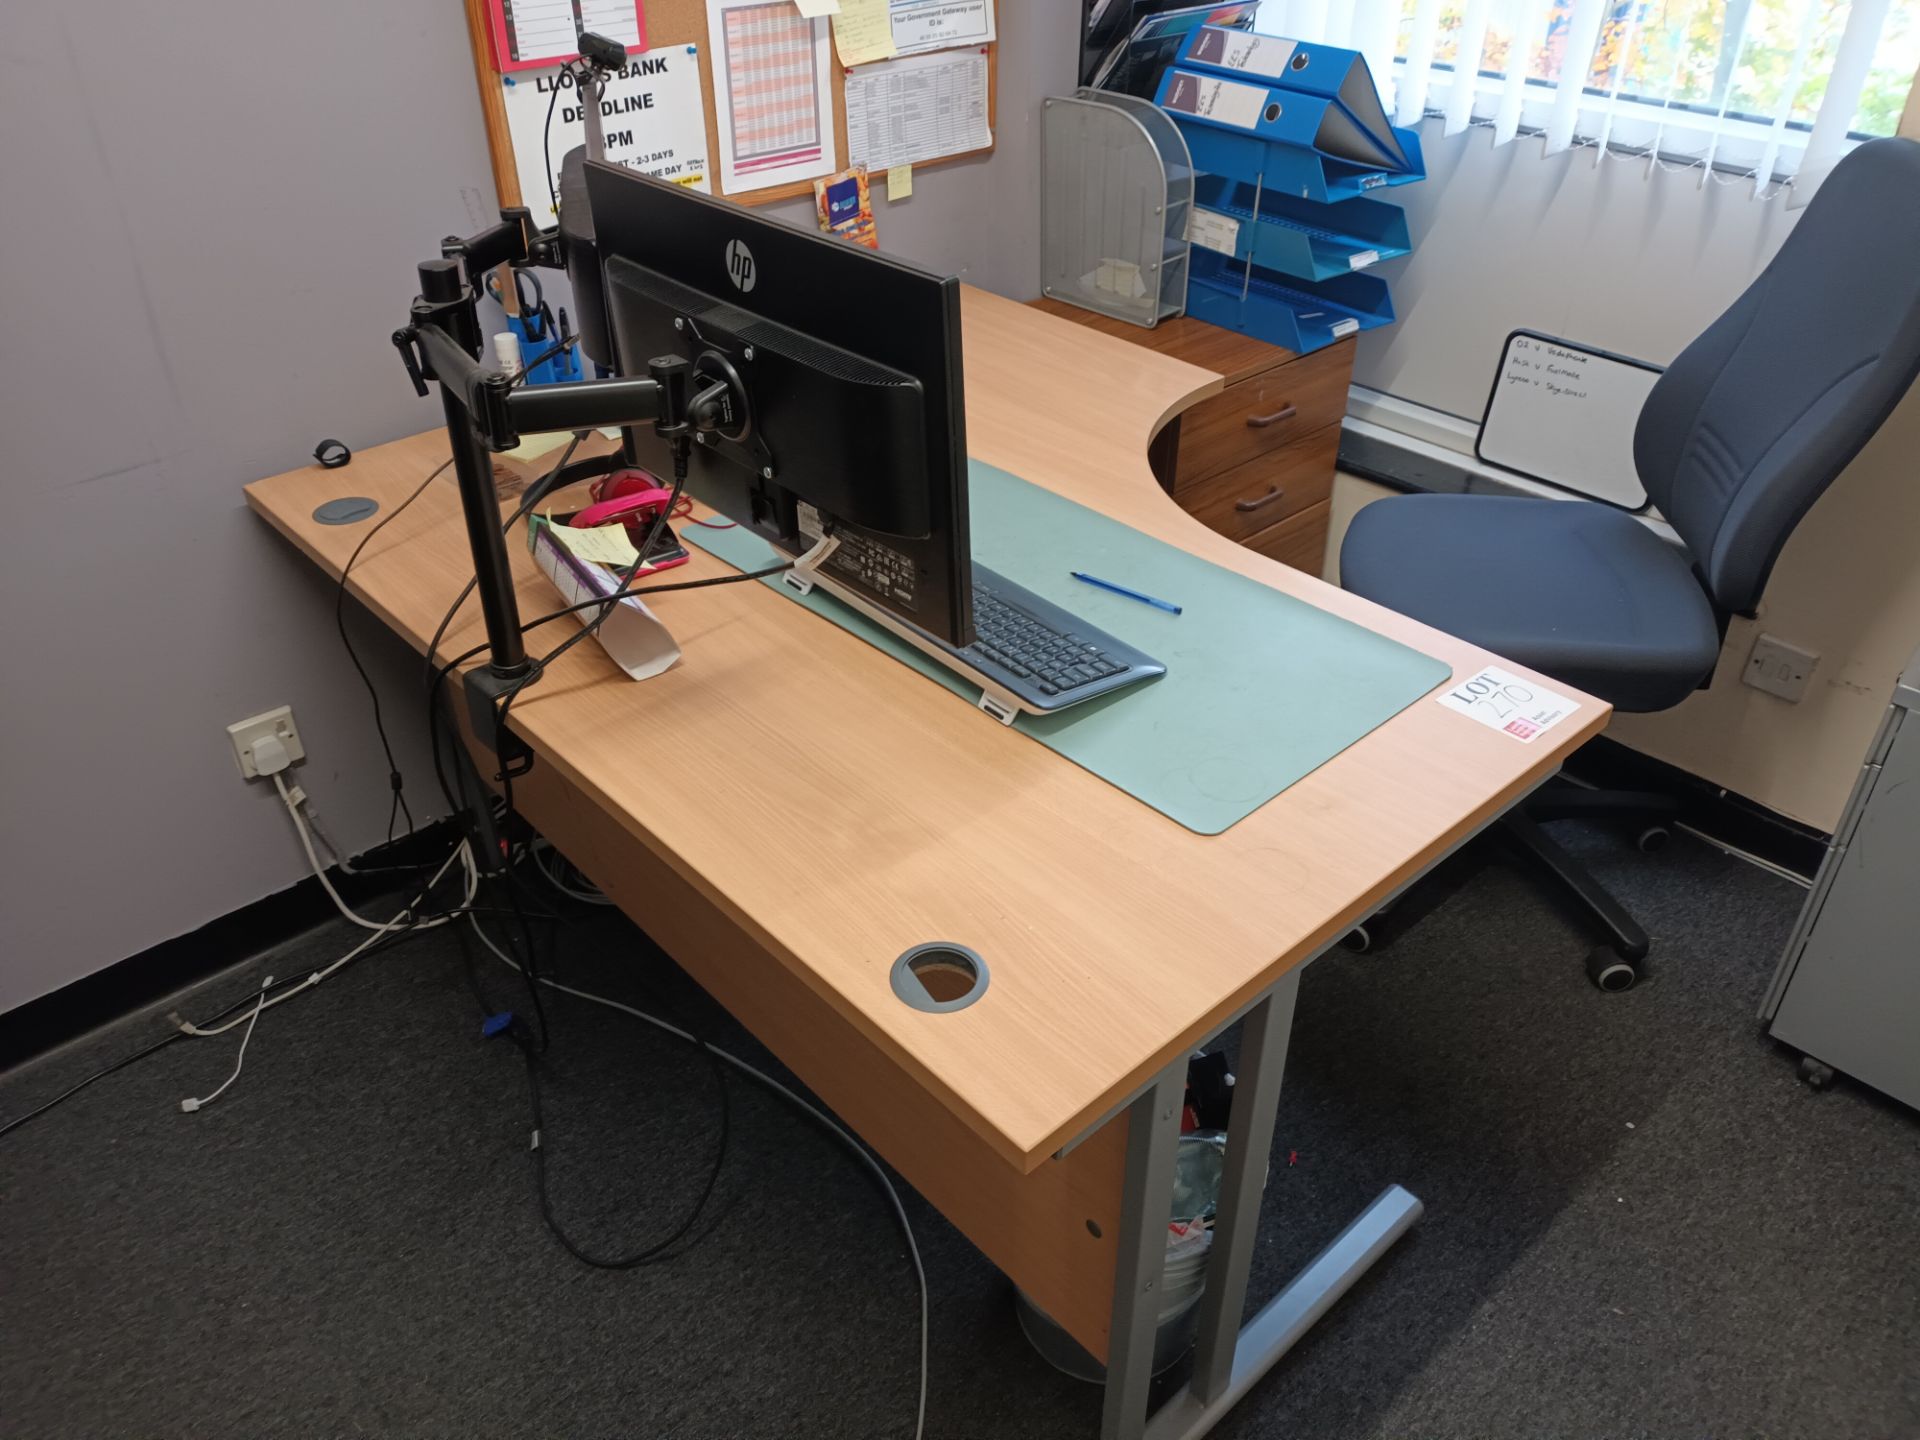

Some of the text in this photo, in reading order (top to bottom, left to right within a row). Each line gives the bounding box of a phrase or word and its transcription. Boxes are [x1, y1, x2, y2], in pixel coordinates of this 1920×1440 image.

[907, 10, 942, 22] Government
[942, 6, 968, 16] Gateway
[536, 57, 668, 93] LLOS BANK
[562, 93, 654, 123] DEDLINE
[636, 154, 650, 166] 2-3
[651, 149, 674, 162] DAYS
[664, 164, 682, 175] DAY
[730, 240, 753, 292] hp
[1450, 673, 1500, 704] LOT
[1478, 684, 1533, 719] 270
